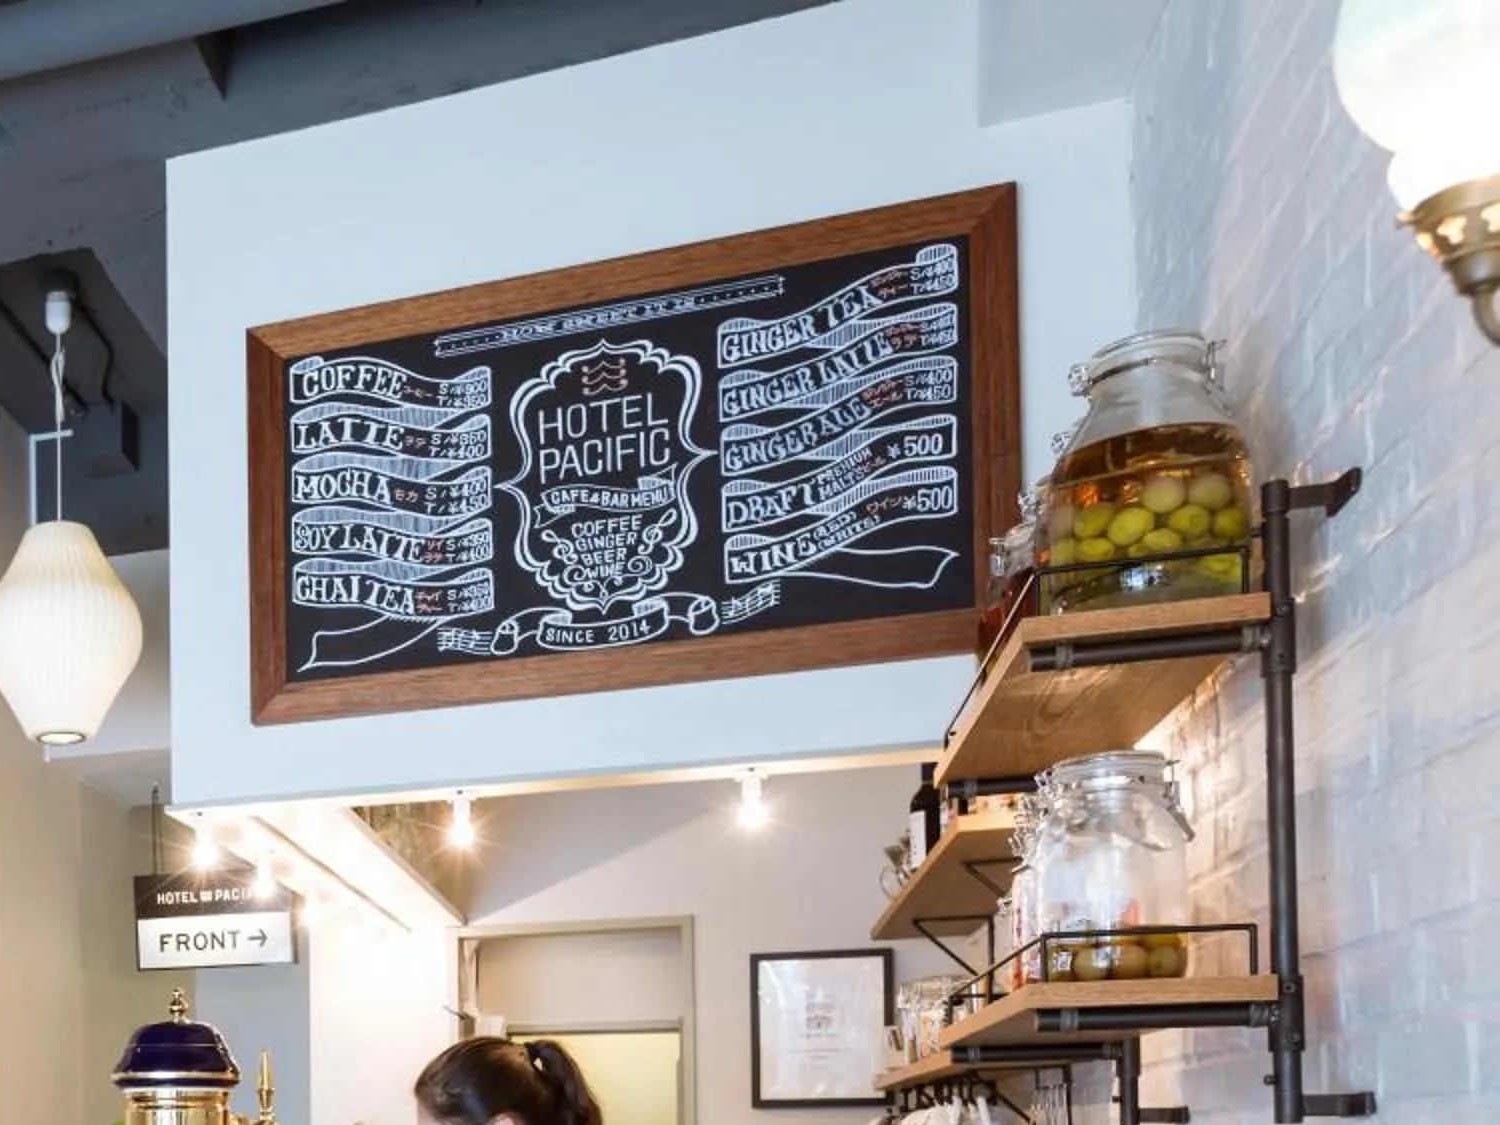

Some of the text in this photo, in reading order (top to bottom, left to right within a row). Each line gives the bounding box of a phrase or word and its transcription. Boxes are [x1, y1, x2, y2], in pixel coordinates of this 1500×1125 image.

[723, 315, 818, 361] GINGER
[818, 284, 883, 327] TEA
[303, 365, 406, 398] COFFEE
[723, 371, 817, 415] GINGER
[817, 330, 895, 384] LATTE
[297, 417, 405, 450] LATTE
[538, 392, 669, 445] HOTEL
[726, 398, 873, 471] GINGER ALE
[539, 428, 670, 485] PACIFIC
[296, 468, 391, 504] MOCHA
[631, 486, 668, 507] MENU
[728, 478, 817, 529] DRAFT
[296, 524, 426, 563] SOY LATTE
[571, 514, 643, 539] COFFEE
[575, 532, 637, 552] GINGER
[581, 547, 627, 566] BEER
[586, 561, 626, 578] WINE
[729, 532, 817, 575] WINE
[297, 575, 415, 615] CHAI TEA
[546, 619, 651, 643] SINCE 2014
[156, 887, 256, 905] HOTEL PACI
[159, 929, 240, 953] FRONT
